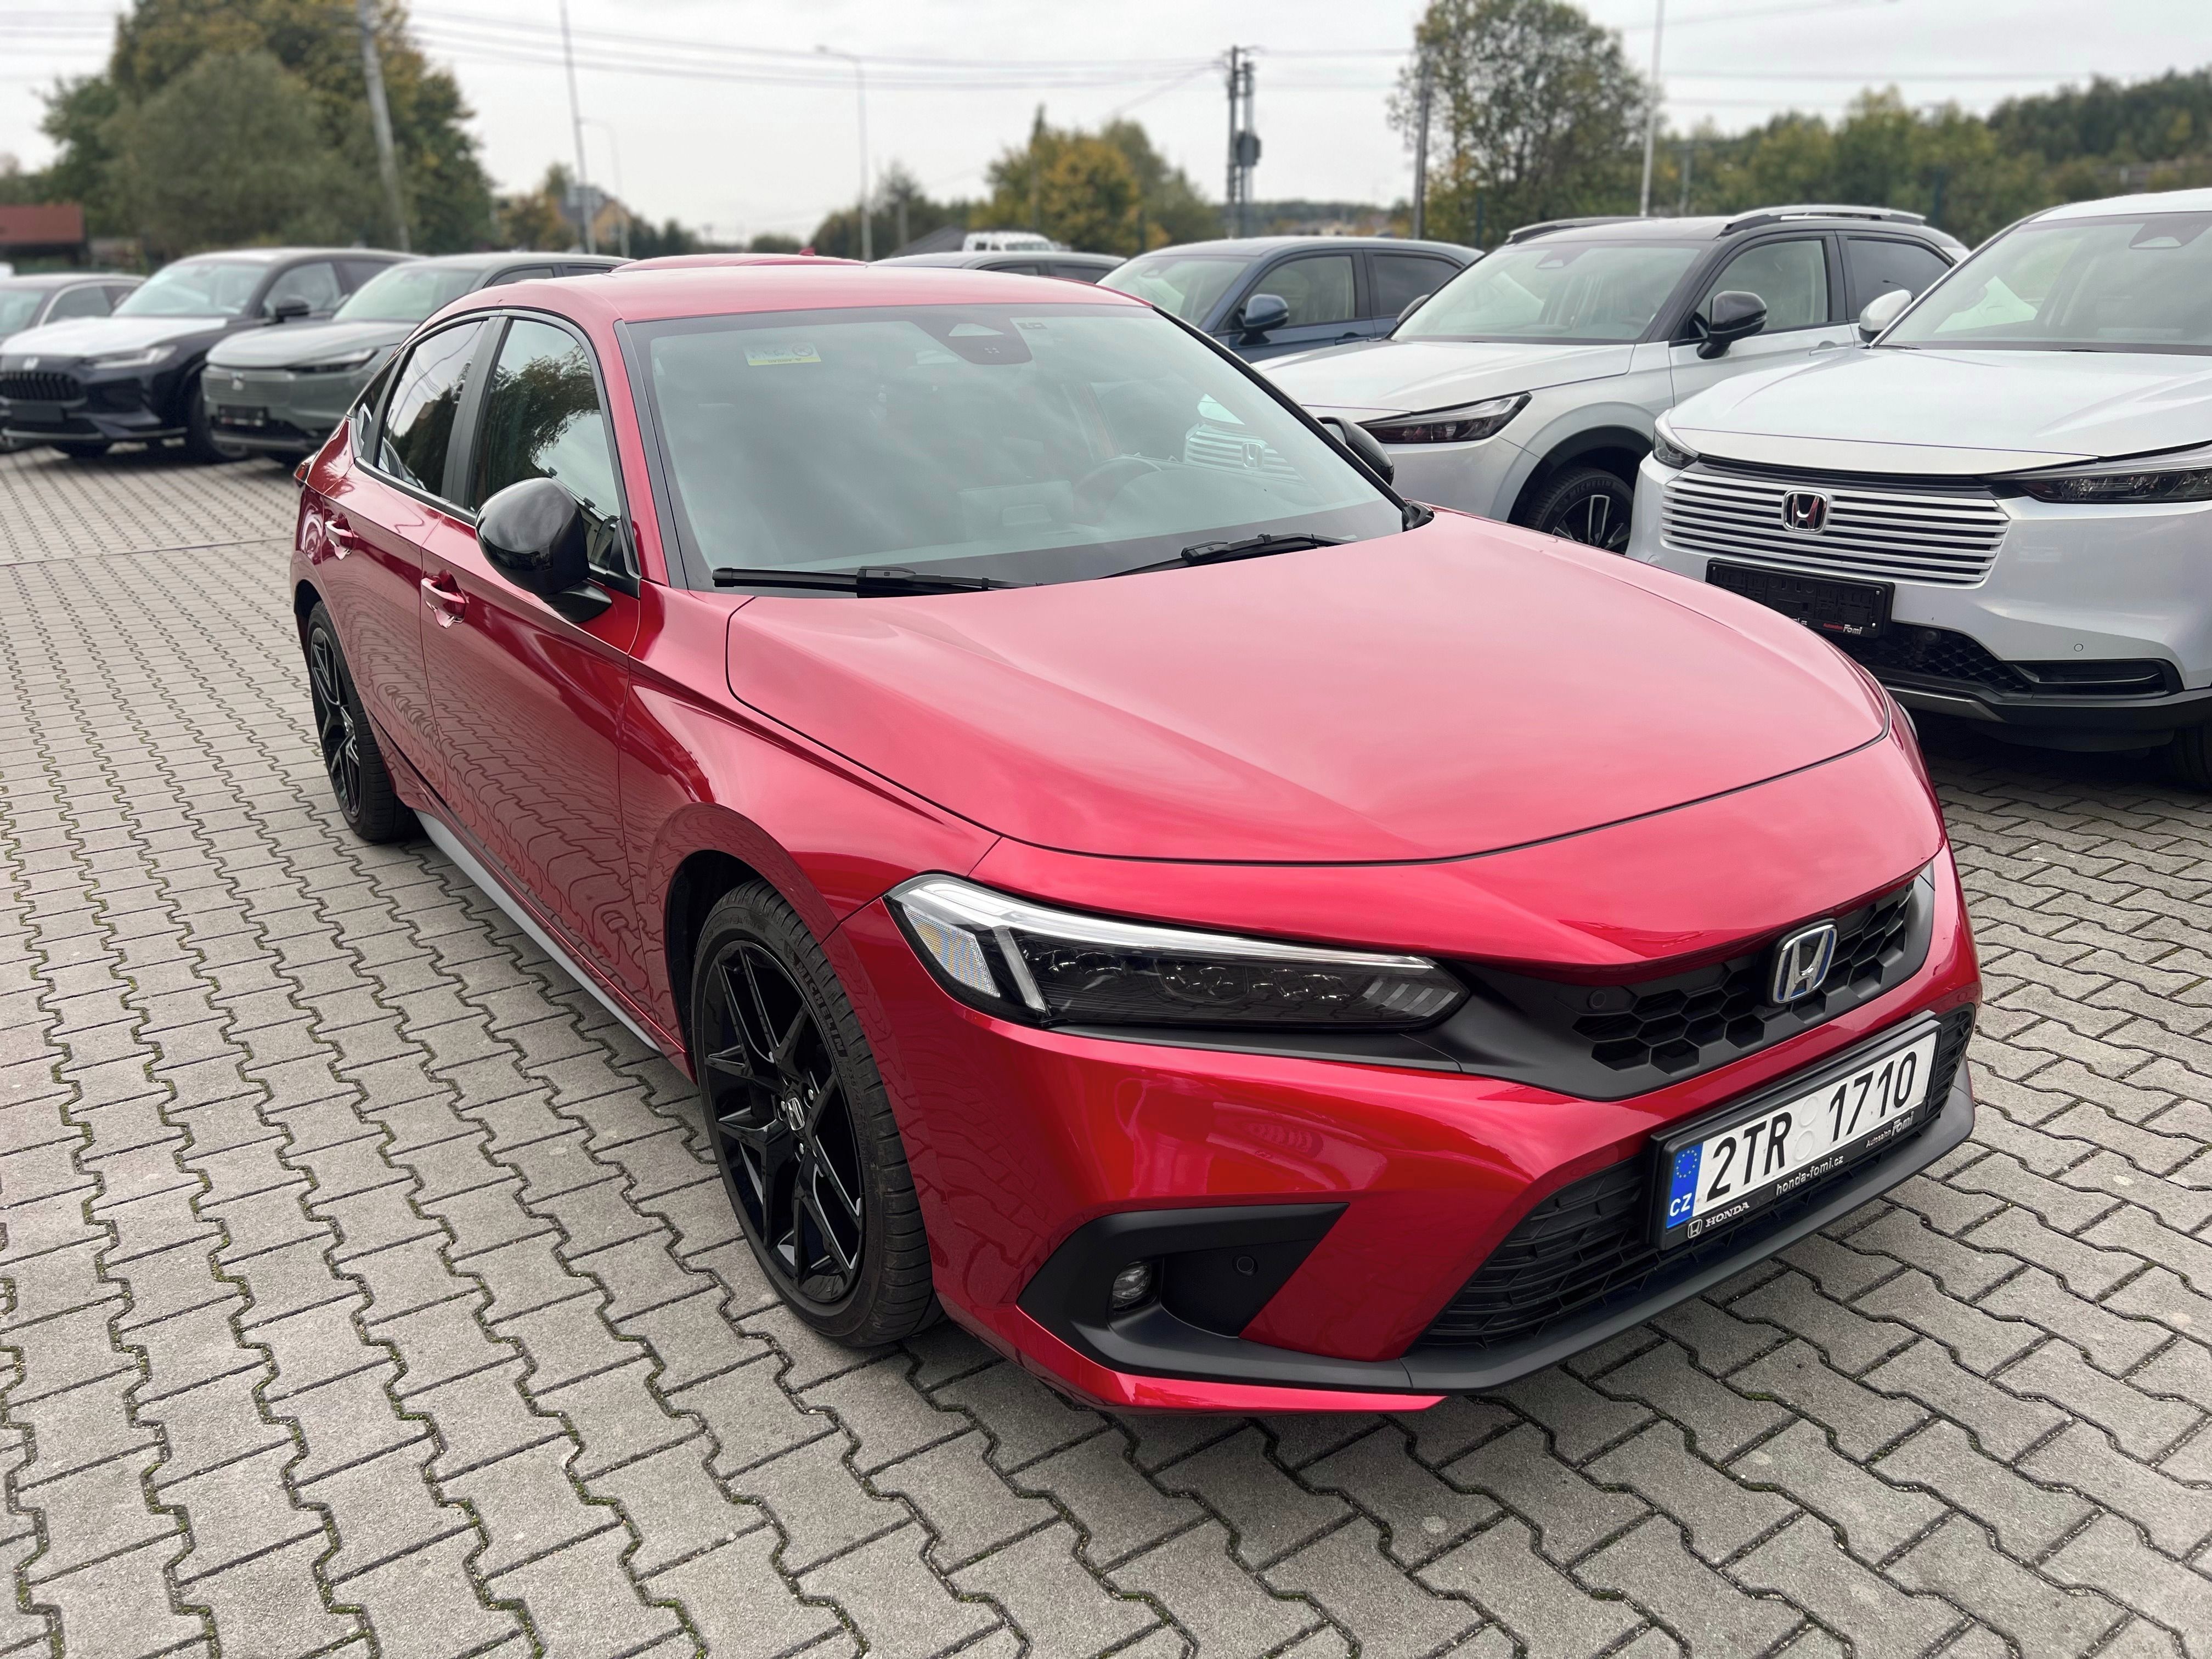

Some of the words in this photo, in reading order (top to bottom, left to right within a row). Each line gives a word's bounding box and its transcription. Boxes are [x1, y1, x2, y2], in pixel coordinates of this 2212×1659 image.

[1843, 624, 1863, 635] Fomi
[796, 961, 846, 1051] MICHELIN
[1706, 1111, 1792, 1202] 2TR
[1829, 1051, 1917, 1142] 1710
[1891, 1111, 1914, 1137] Fomi
[1776, 1155, 1844, 1196] honda-fomi.cz
[1669, 1193, 1692, 1217] CZ
[1705, 1201, 1750, 1228] HONDA
